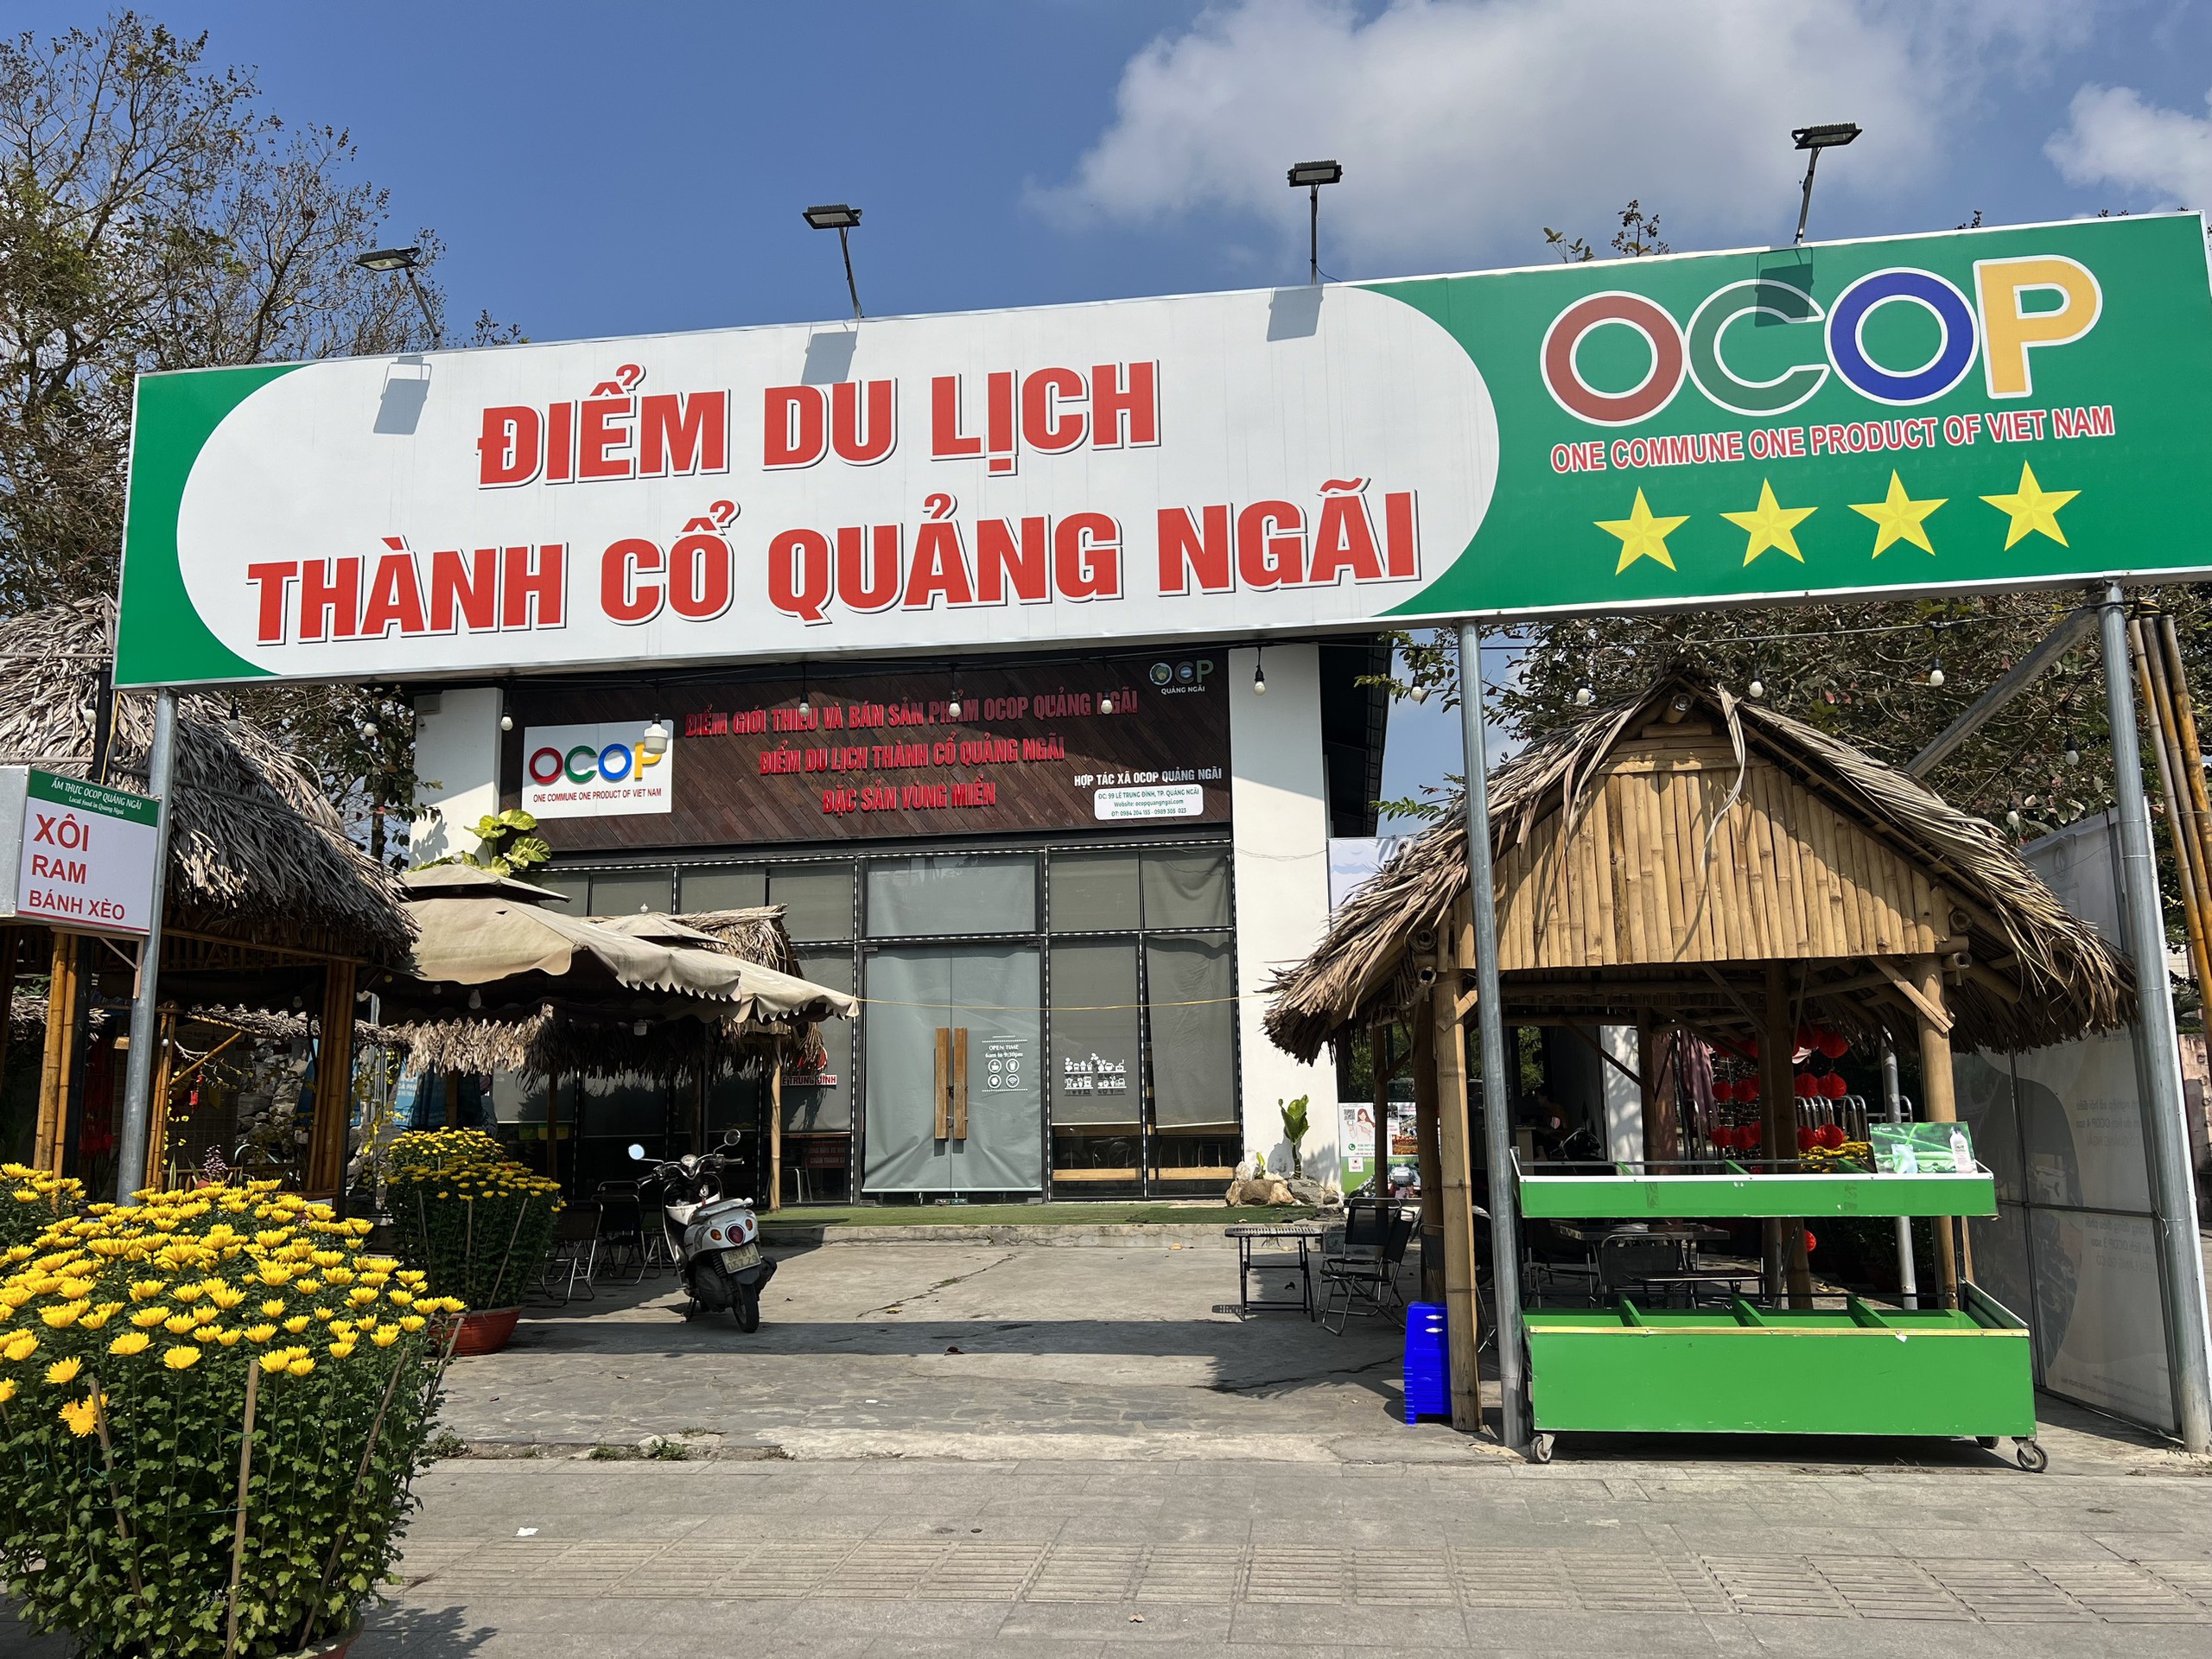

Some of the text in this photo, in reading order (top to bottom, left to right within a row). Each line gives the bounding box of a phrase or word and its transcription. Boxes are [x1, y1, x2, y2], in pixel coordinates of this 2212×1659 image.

[1541, 255, 2103, 426] OCOP
[477, 360, 1160, 488] ĐIỂM DU LỊCH
[1551, 405, 2115, 474] ONE COMMUNE ONE PRODUCT OF VIET NAM
[246, 478, 1421, 645] THÀNH CỔ QUẢNG NGÃI
[685, 703, 727, 737] ĐIỂM
[733, 705, 766, 734] GIỚI
[823, 702, 842, 730] VÀ
[849, 700, 884, 728] BÁN
[889, 696, 923, 726] SẢN
[984, 697, 1028, 721] OCOP
[1033, 686, 1090, 720] QUẢNG
[529, 741, 662, 785] OCOP
[760, 732, 1065, 774] ĐIỂM DU LỊCH THÀNH CỔ QUẢNG NGÃI
[84, 788, 102, 799] OCOP
[533, 788, 662, 803] ONE COMMUNE ONE PRODUCT OF VIET NAM
[823, 774, 995, 817] ĐẶC SẢN VÙNG MIỀN
[1074, 766, 1222, 788] HỢP TÁC XÃ OCOP QUẢNG NGÃI
[69, 796, 81, 804] Local
[33, 813, 89, 851] XÔI
[31, 854, 86, 885] RAM
[29, 888, 125, 920] BÁNH XÈO
